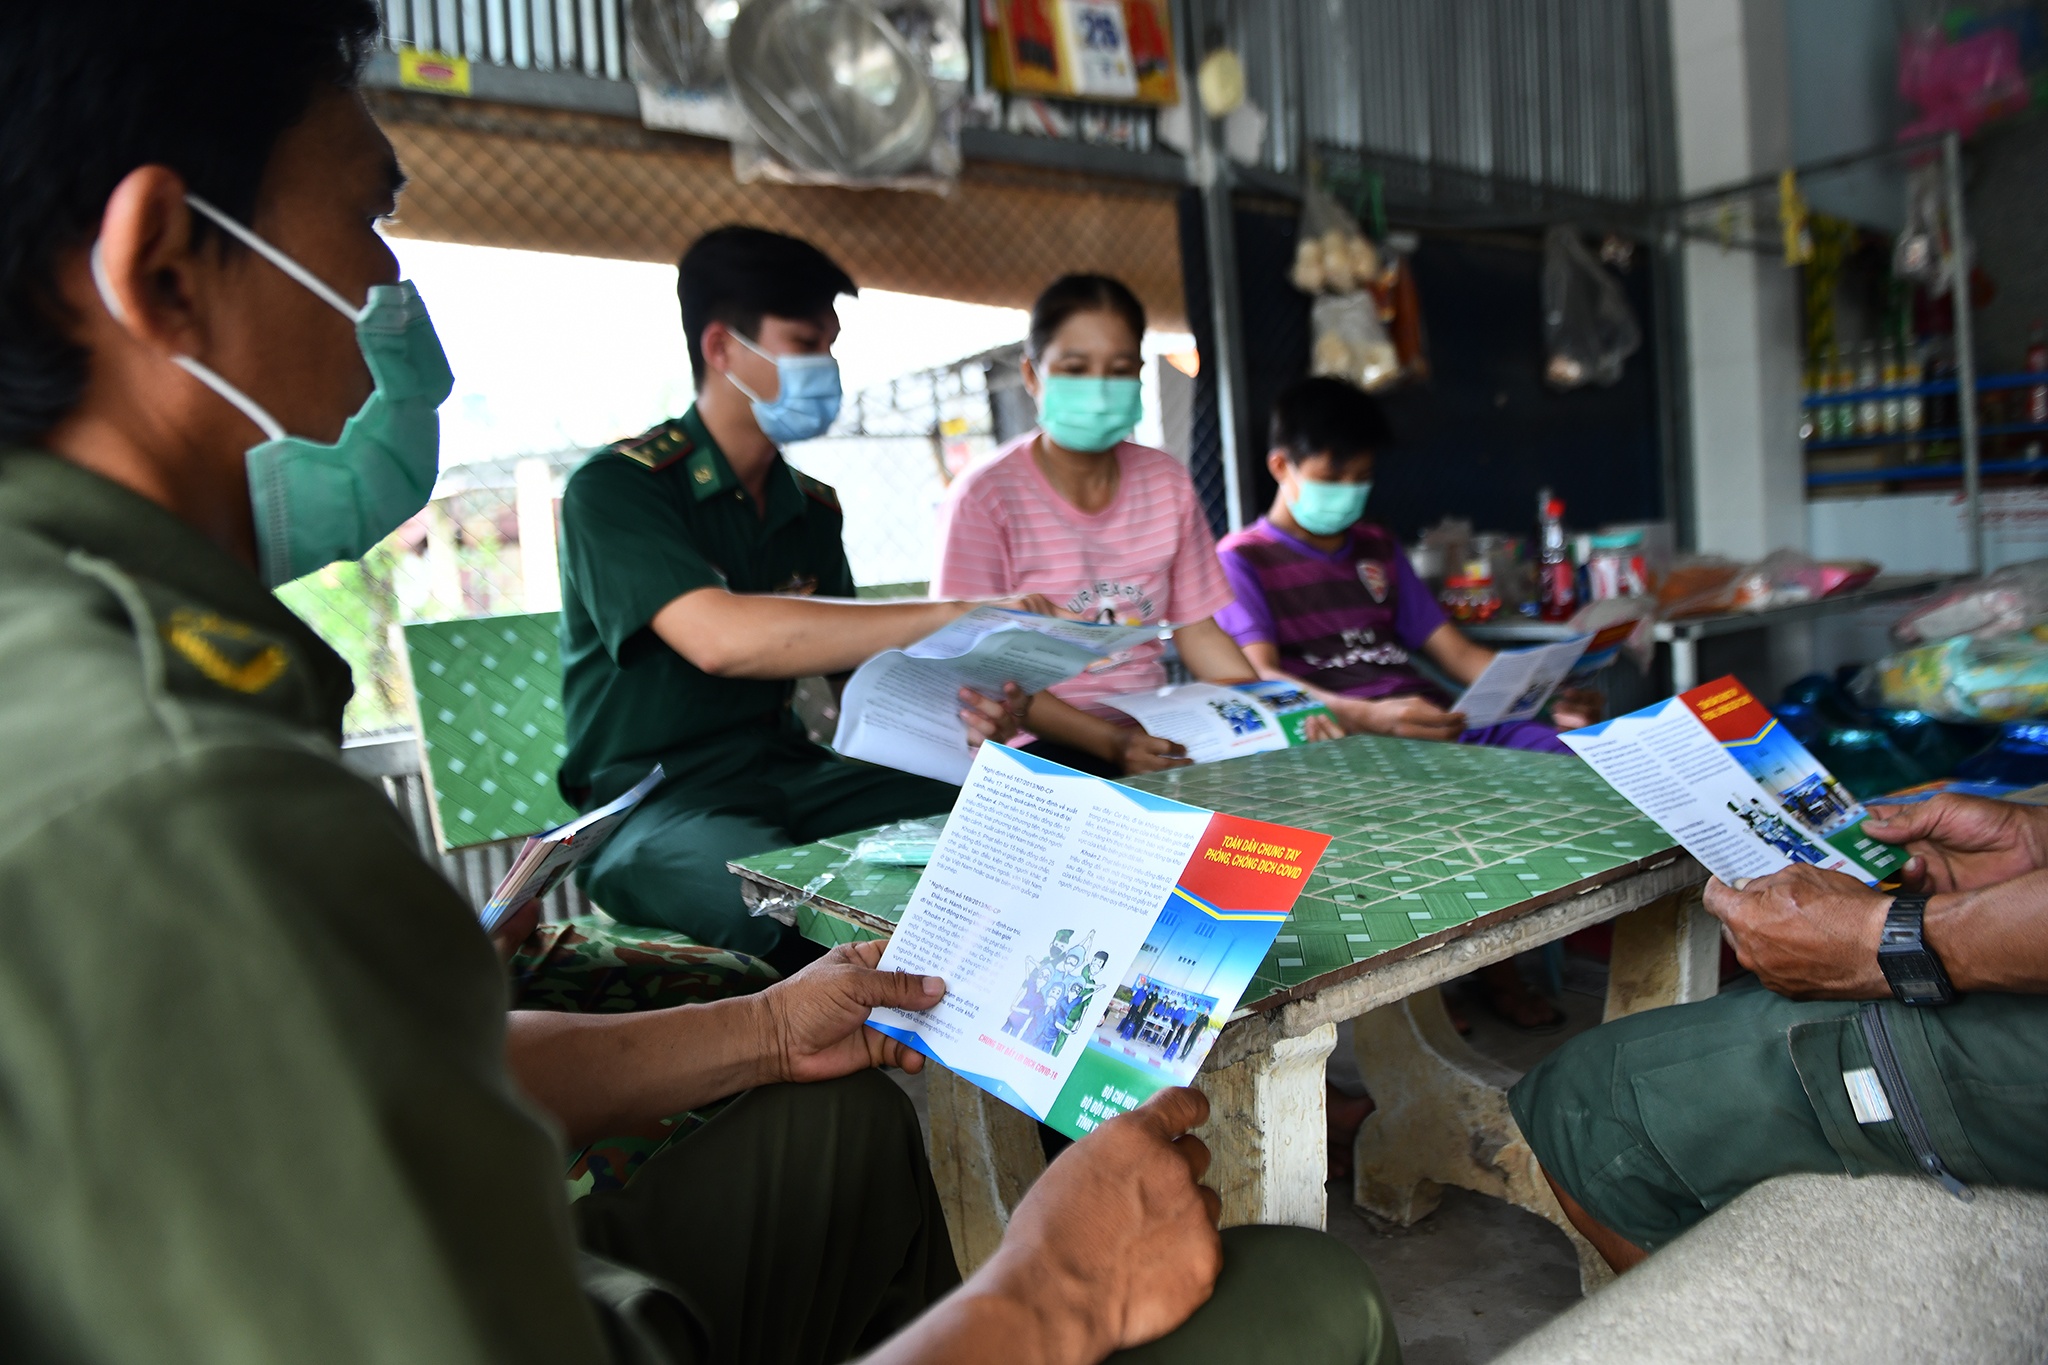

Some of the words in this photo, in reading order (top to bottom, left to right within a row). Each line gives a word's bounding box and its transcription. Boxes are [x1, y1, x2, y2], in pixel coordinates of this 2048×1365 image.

[1222, 835, 1242, 850] TOÀN
[1241, 838, 1259, 853] DÂN
[1257, 843, 1285, 859] CHUNG
[1284, 848, 1302, 862] TAY
[1204, 848, 1232, 866] PHÒNG,
[1232, 854, 1259, 870] CHỐNG
[1256, 859, 1278, 874] DỊCH
[1276, 864, 1302, 879] COVID
[1034, 1062, 1058, 1080] COVID-19
[1080, 1095, 1094, 1112] BỘ
[1101, 1084, 1115, 1101] BỘ
[1122, 1095, 1139, 1111] HUY
